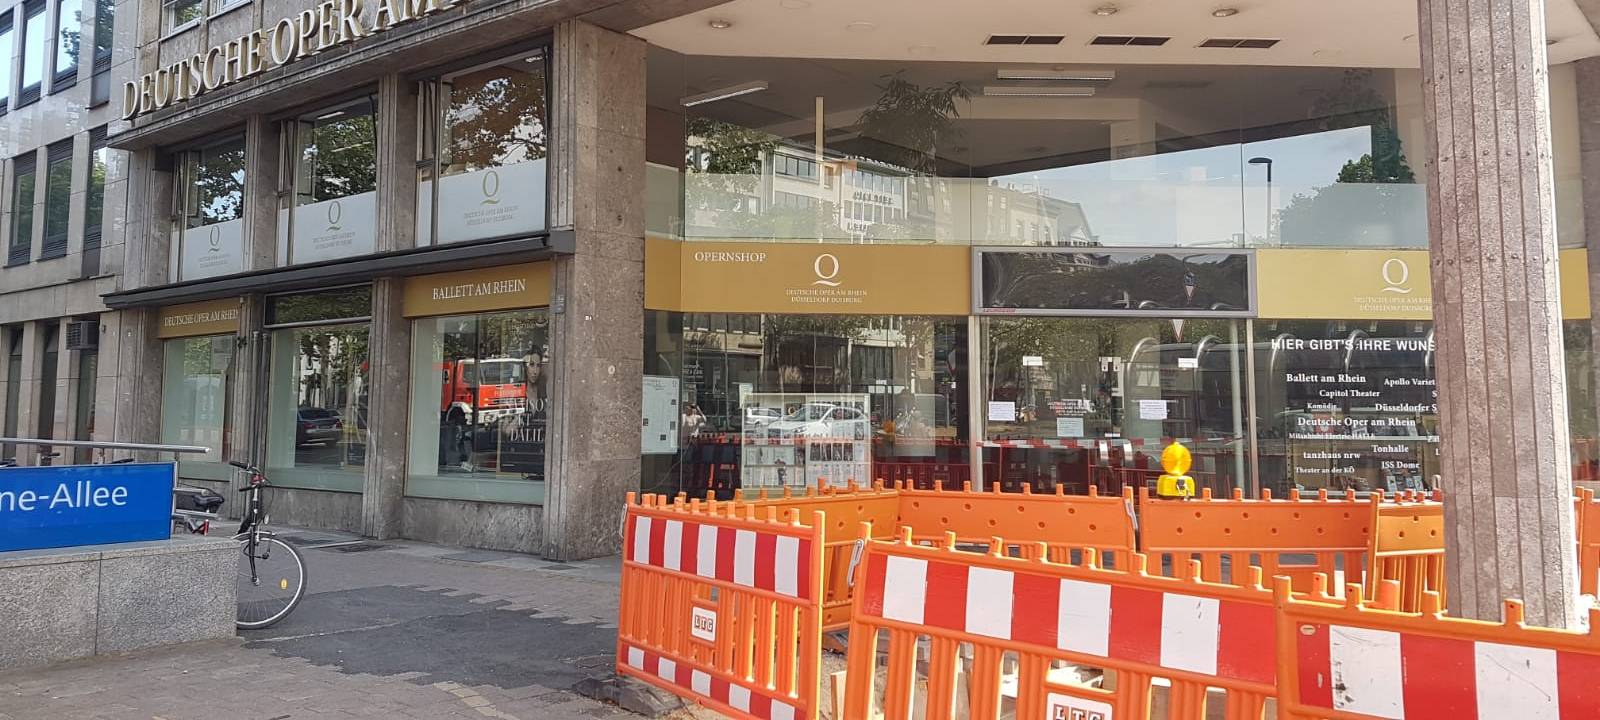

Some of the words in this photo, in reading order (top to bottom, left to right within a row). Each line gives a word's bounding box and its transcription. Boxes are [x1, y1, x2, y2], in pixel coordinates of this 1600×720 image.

[122, 28, 266, 121] DEUTSCHE
[271, 0, 366, 65] OPER
[694, 251, 766, 262] OPERNSHOP
[432, 284, 474, 300] BALLETT
[475, 282, 491, 296] AM
[493, 278, 526, 294] RHEIN
[164, 314, 194, 327] DEUTSCHE
[194, 312, 209, 323] OPER
[209, 311, 220, 321] AM
[1271, 339, 1304, 350] HIER
[1310, 339, 1354, 350] GIBT'S
[1360, 340, 1391, 351] IHRE
[1286, 373, 1318, 383] Ballett
[1320, 375, 1336, 383] am
[1338, 373, 1367, 383] Rhein
[1384, 378, 1410, 387] Apollo
[1319, 389, 1349, 399] Capitol
[1350, 389, 1380, 397] Theater
[1375, 403, 1430, 412] Düsseldorfer
[1297, 416, 1342, 426] Deutsche
[1344, 416, 1368, 428] Oper
[1388, 417, 1416, 426] Rhein
[1371, 444, 1409, 453] Tonhalle
[1303, 451, 1342, 459] tanzhaus
[1382, 461, 1395, 469] ISS
[1397, 461, 1420, 469] Dome
[0, 480, 128, 511] ne-Allee
[695, 615, 714, 632] LTG
